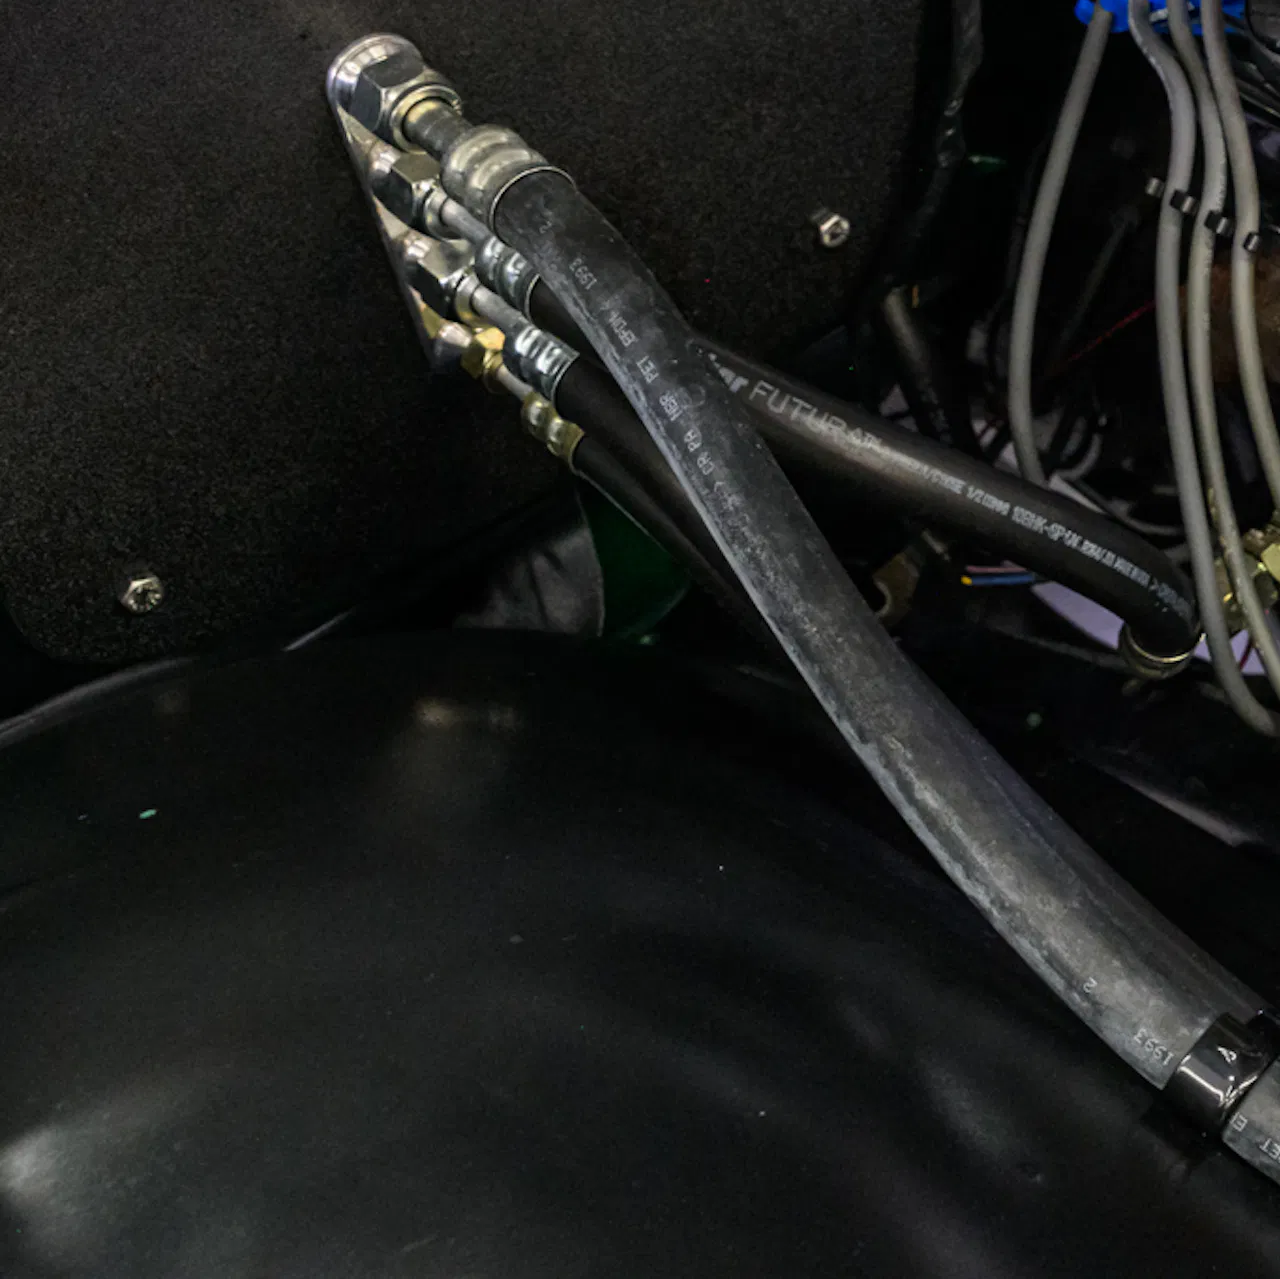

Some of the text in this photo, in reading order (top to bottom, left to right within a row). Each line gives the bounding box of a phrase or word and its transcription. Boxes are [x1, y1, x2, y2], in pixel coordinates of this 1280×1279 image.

[566, 254, 598, 291] 1993
[632, 353, 662, 384] PET
[655, 388, 686, 421] NBR
[678, 426, 704, 453] PA
[1080, 975, 1176, 1068] 1993 2
